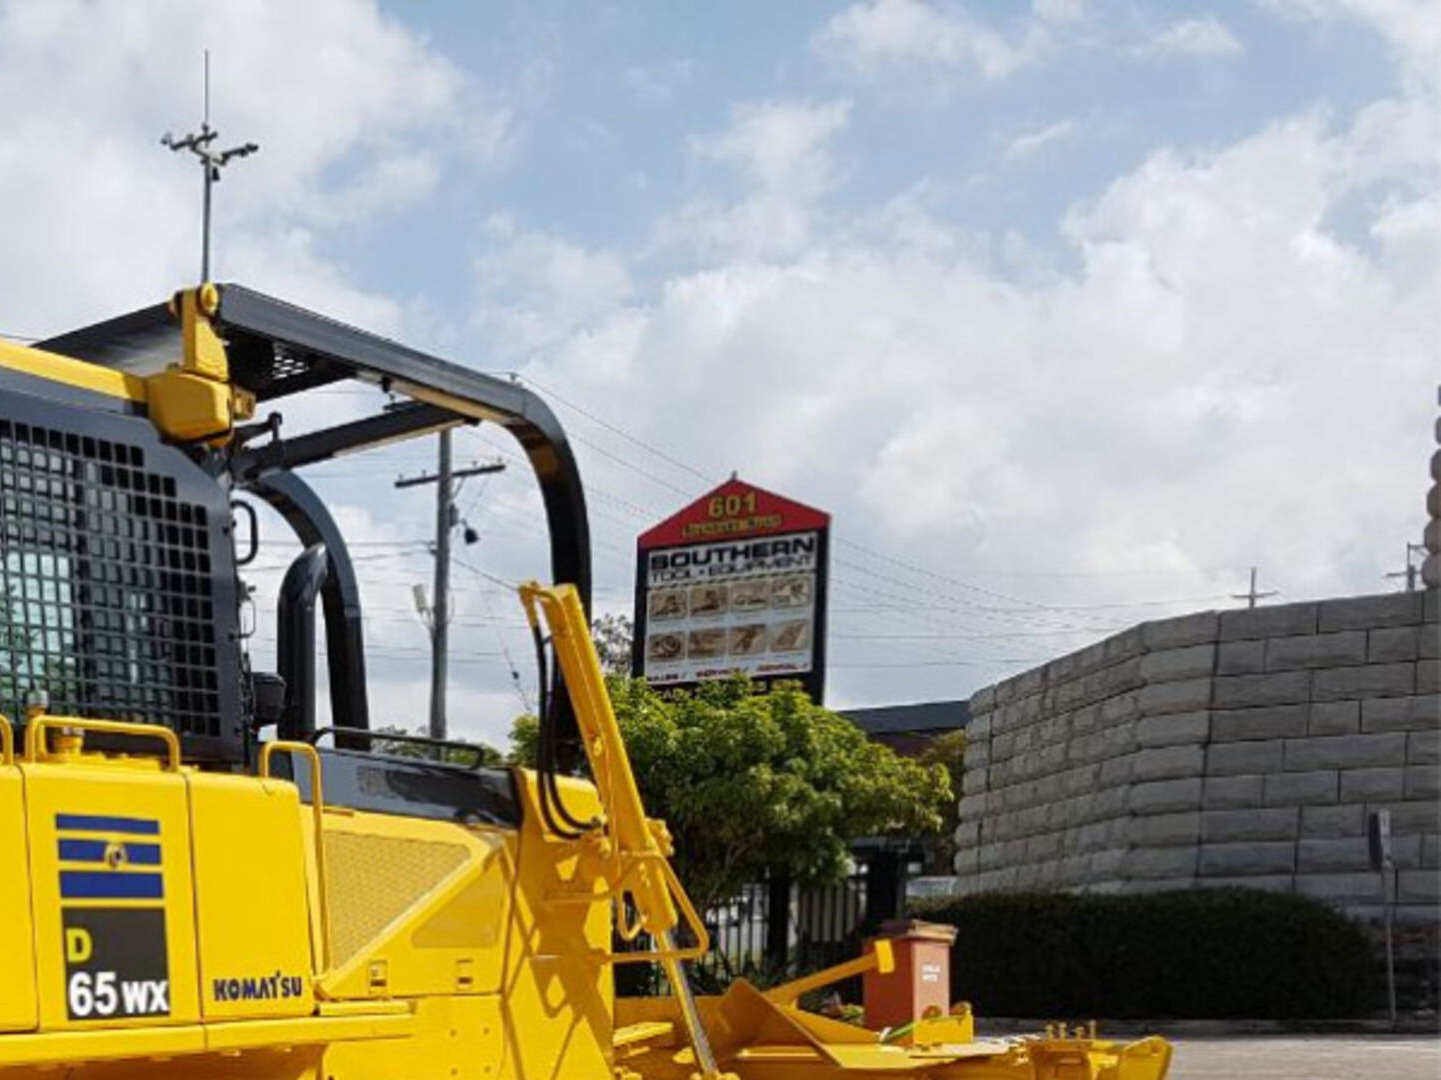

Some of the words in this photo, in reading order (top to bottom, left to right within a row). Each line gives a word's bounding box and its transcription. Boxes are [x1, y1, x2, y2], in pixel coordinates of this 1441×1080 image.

[708, 491, 756, 517] 601
[650, 537, 815, 571] SOUTHERN
[66, 928, 93, 963] D
[213, 969, 303, 1001] KOMATSU
